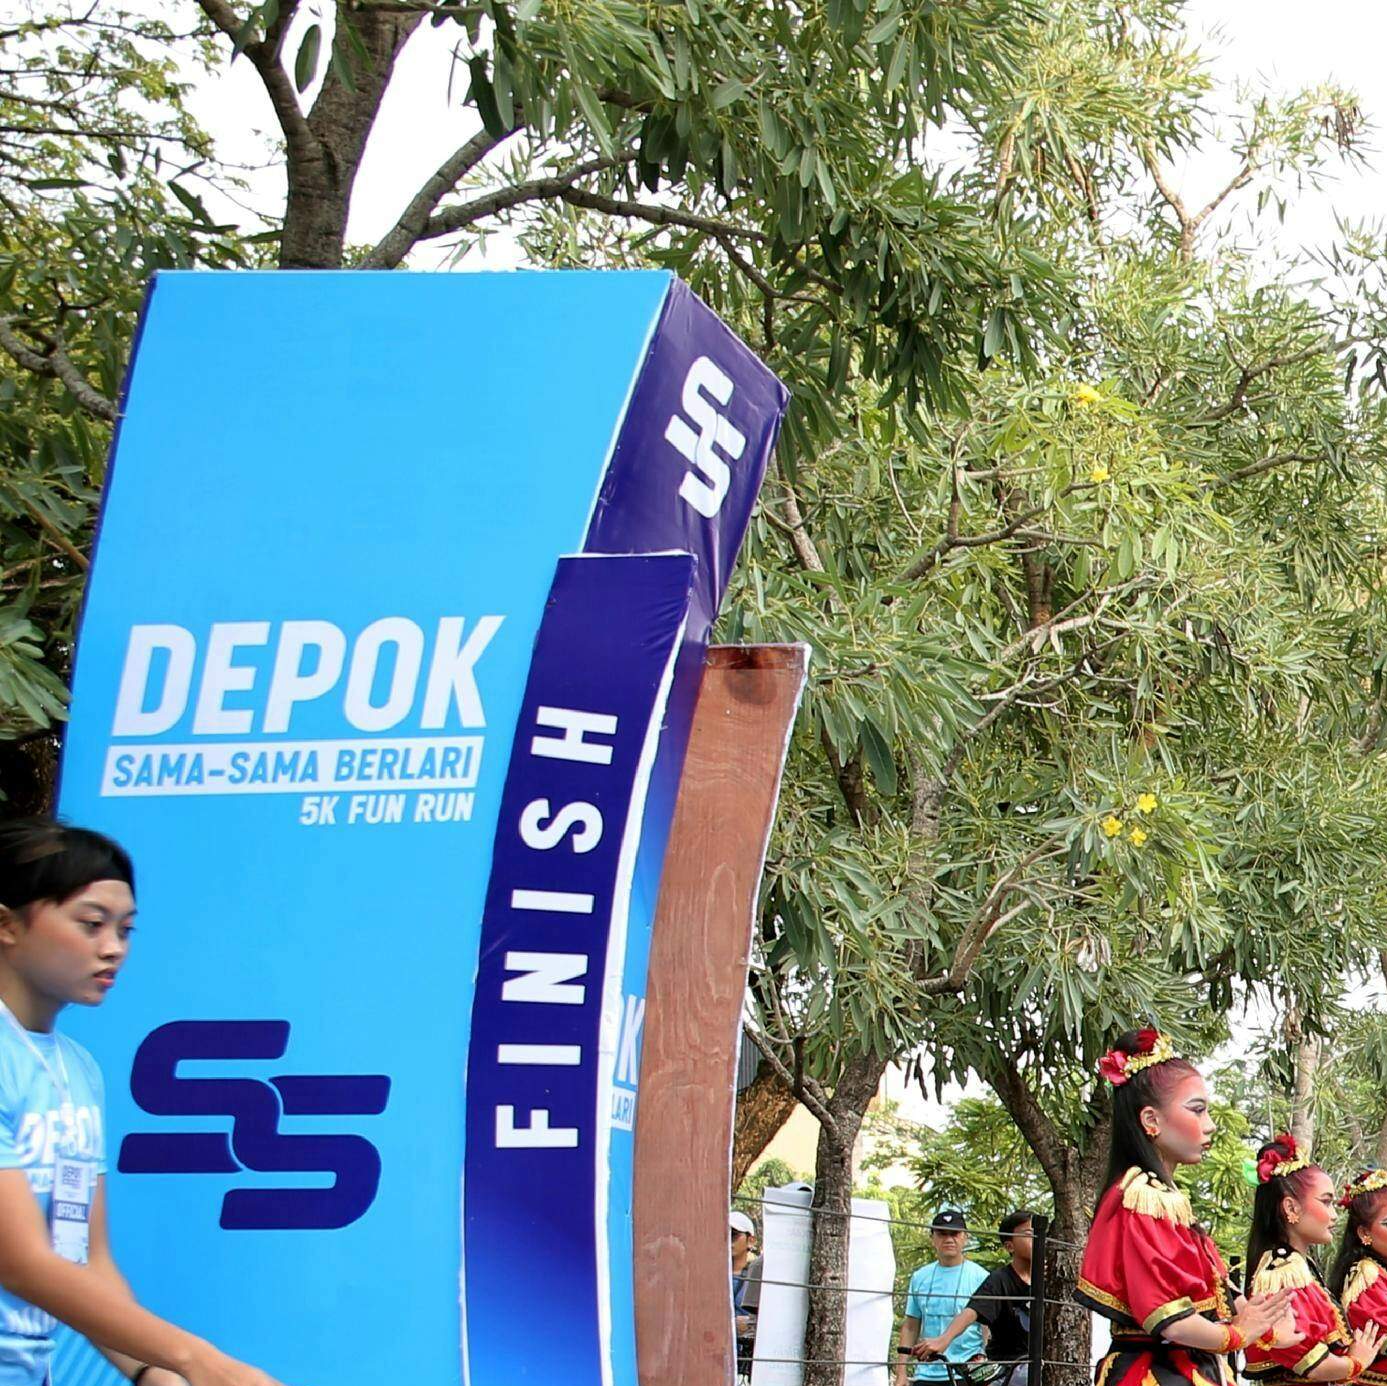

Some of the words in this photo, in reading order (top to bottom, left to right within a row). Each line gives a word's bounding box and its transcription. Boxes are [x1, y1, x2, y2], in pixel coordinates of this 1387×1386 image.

[111, 615, 506, 738] DEPOK
[113, 752, 320, 788] SAMA-SAMA
[333, 748, 474, 783] BERLARI
[299, 795, 339, 826] 5K
[348, 793, 404, 824] FUN
[414, 792, 474, 823] RUN
[496, 705, 619, 1150] FINISH
